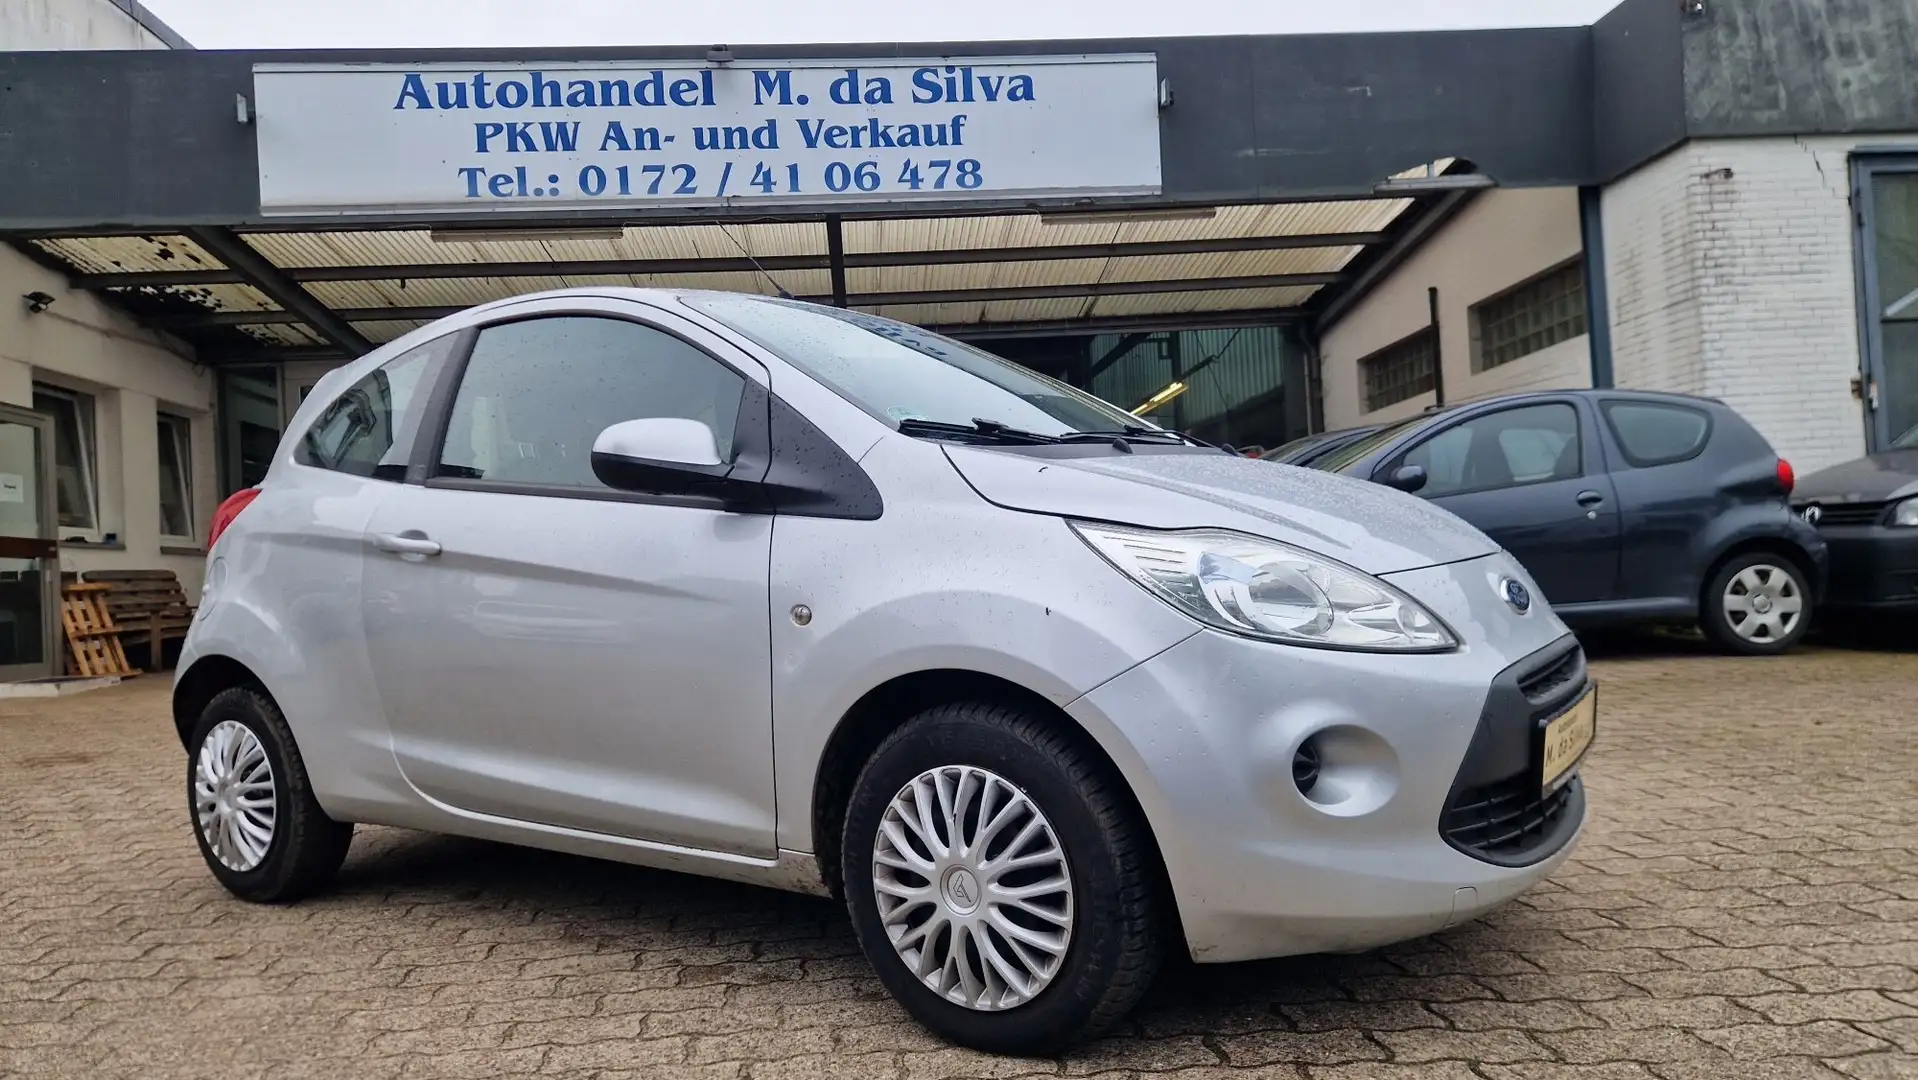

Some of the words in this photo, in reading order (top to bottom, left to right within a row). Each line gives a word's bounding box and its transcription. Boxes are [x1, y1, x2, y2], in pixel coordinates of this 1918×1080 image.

[394, 70, 716, 110] Autohandel
[753, 70, 810, 106] M.
[829, 69, 894, 105] da
[912, 65, 1036, 104] Silva
[475, 121, 581, 153] PKW
[600, 121, 675, 151] An-
[693, 119, 780, 151] und
[796, 114, 967, 149] Verkauf
[458, 166, 560, 198] Tel.:
[578, 163, 698, 196] 0172
[716, 161, 733, 197] /
[749, 160, 802, 194] 41
[823, 161, 882, 192] 06
[897, 158, 984, 191] 478
